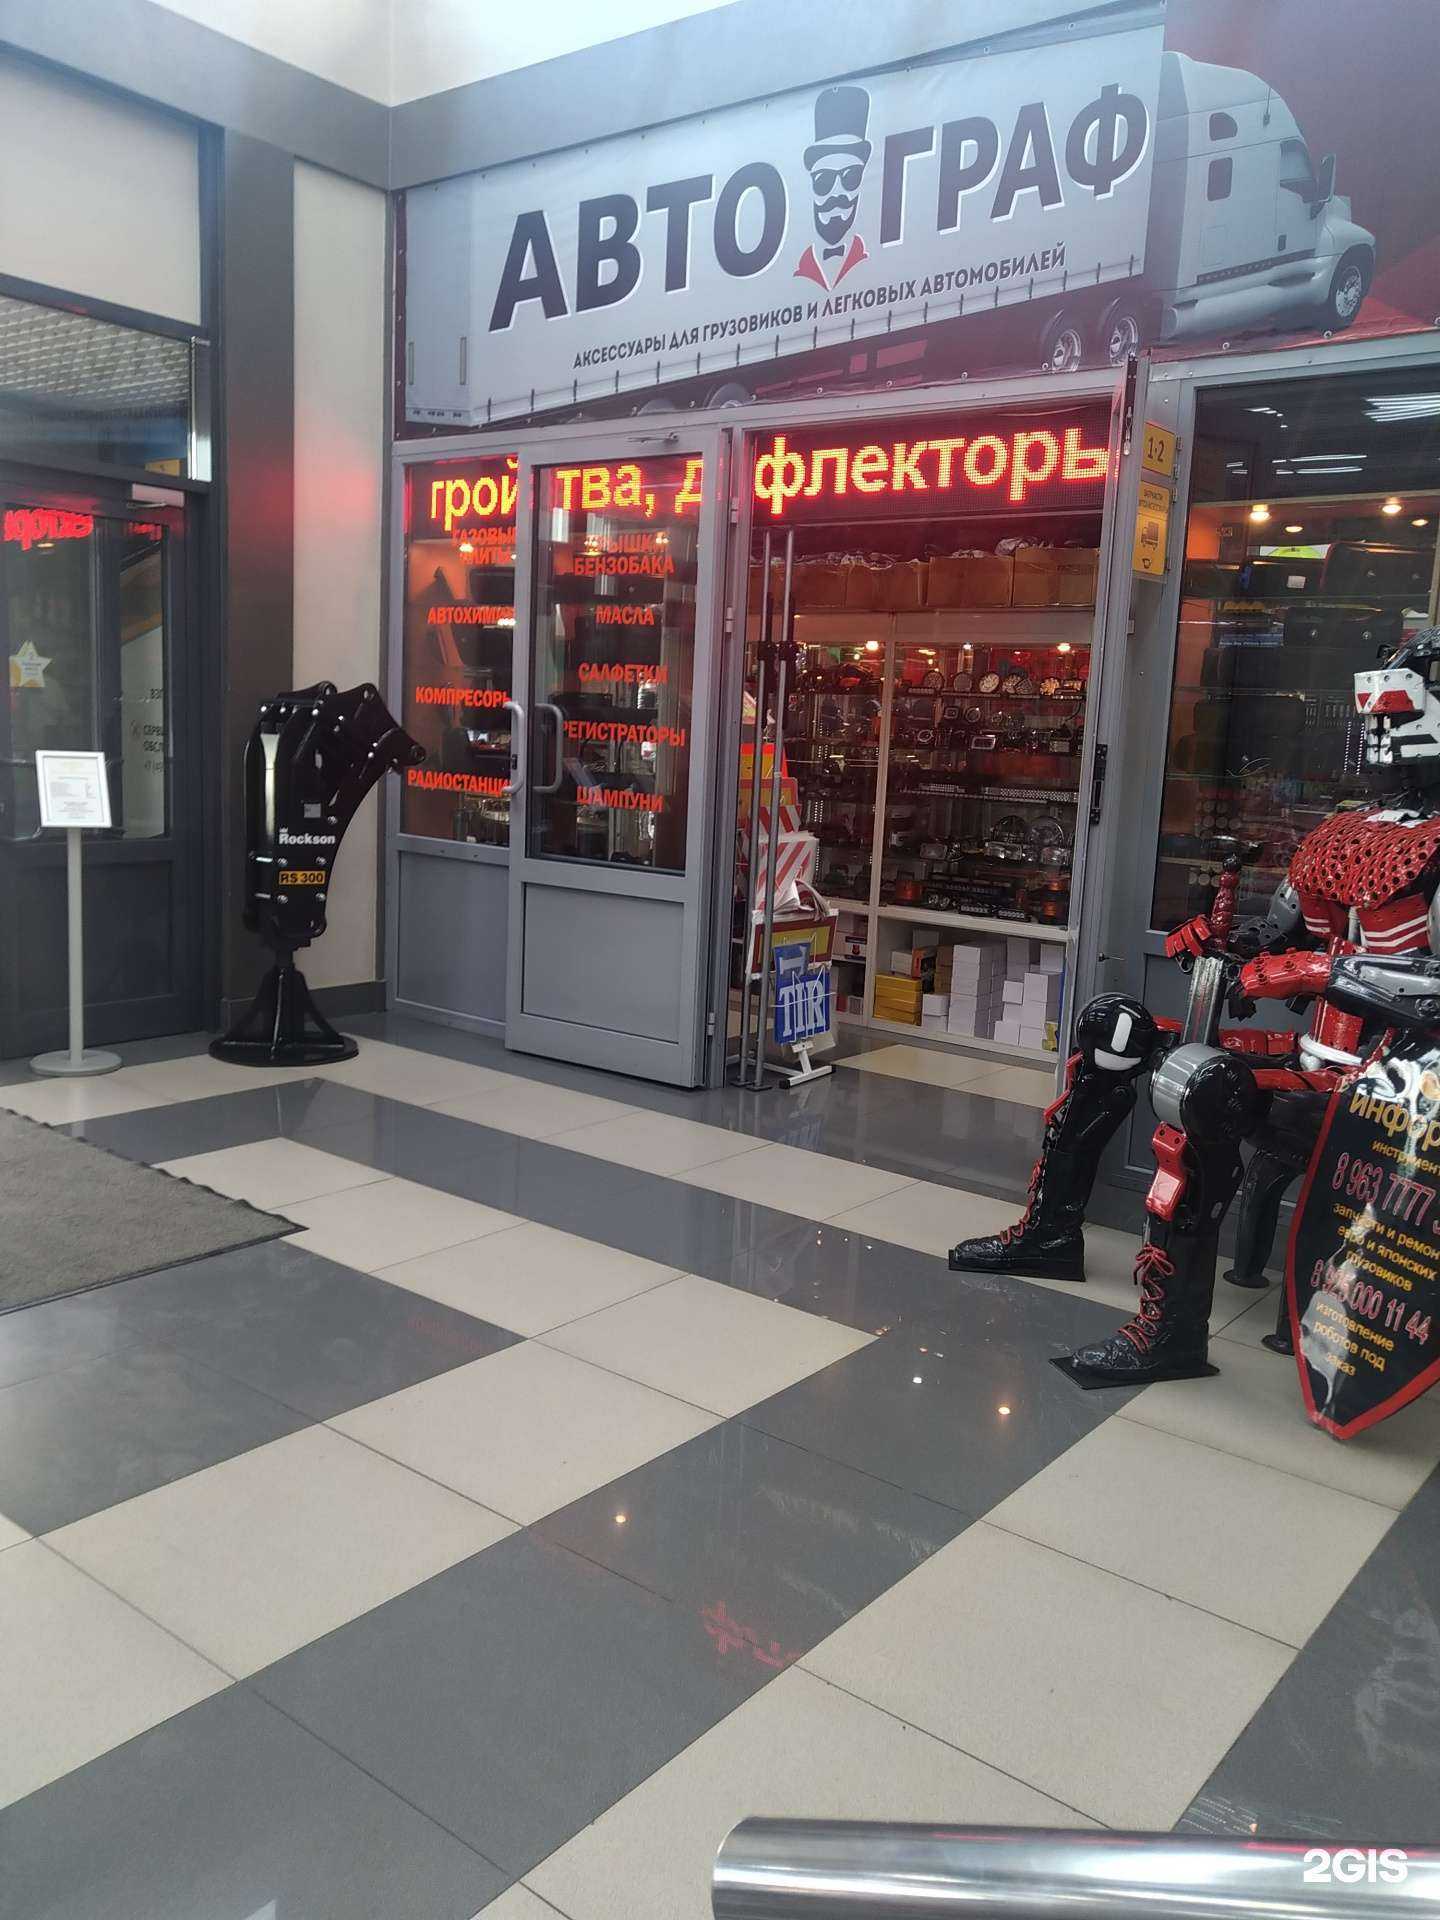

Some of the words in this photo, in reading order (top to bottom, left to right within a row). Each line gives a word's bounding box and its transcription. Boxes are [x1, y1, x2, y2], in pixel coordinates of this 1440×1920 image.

[488, 161, 788, 332] АВТО
[879, 83, 1150, 247] ГРАФ
[573, 333, 666, 370] АКСЕССУАРЫ
[668, 326, 699, 351] ДЛЯ
[702, 305, 802, 343] ГРУЗОВИКОВ
[807, 301, 818, 321] И
[822, 279, 916, 318] ЛЕГКОВЫХ
[919, 240, 1066, 297] АВТОМОБИЛЕЙ
[574, 556, 675, 576] БЕНЗОБАКА
[595, 604, 654, 625] МАСЛА
[578, 662, 668, 686] САЛФЕТКИ
[576, 785, 664, 813] ШАМПУНИ
[279, 833, 336, 846] Rockson
[280, 872, 298, 884] RS
[300, 872, 323, 884] 300
[779, 979, 826, 1038] TIR
[1331, 1152, 1350, 1190] 8
[1346, 1158, 1384, 1205] 963
[1382, 1172, 1437, 1227] 7777
[1386, 1227, 1396, 1240] и
[1345, 1250, 1413, 1292] грузовиков
[1366, 1240, 1377, 1252] и
[1377, 1245, 1438, 1282] японских
[1311, 1259, 1324, 1288] 8
[1350, 1280, 1384, 1320] 000
[1384, 1298, 1408, 1332] 11
[1405, 1310, 1432, 1346] 44
[1313, 1320, 1359, 1354] роботов
[1359, 1345, 1386, 1373] под
[1315, 1301, 1395, 1352] изготовление
[1326, 1351, 1356, 1377] заказ
